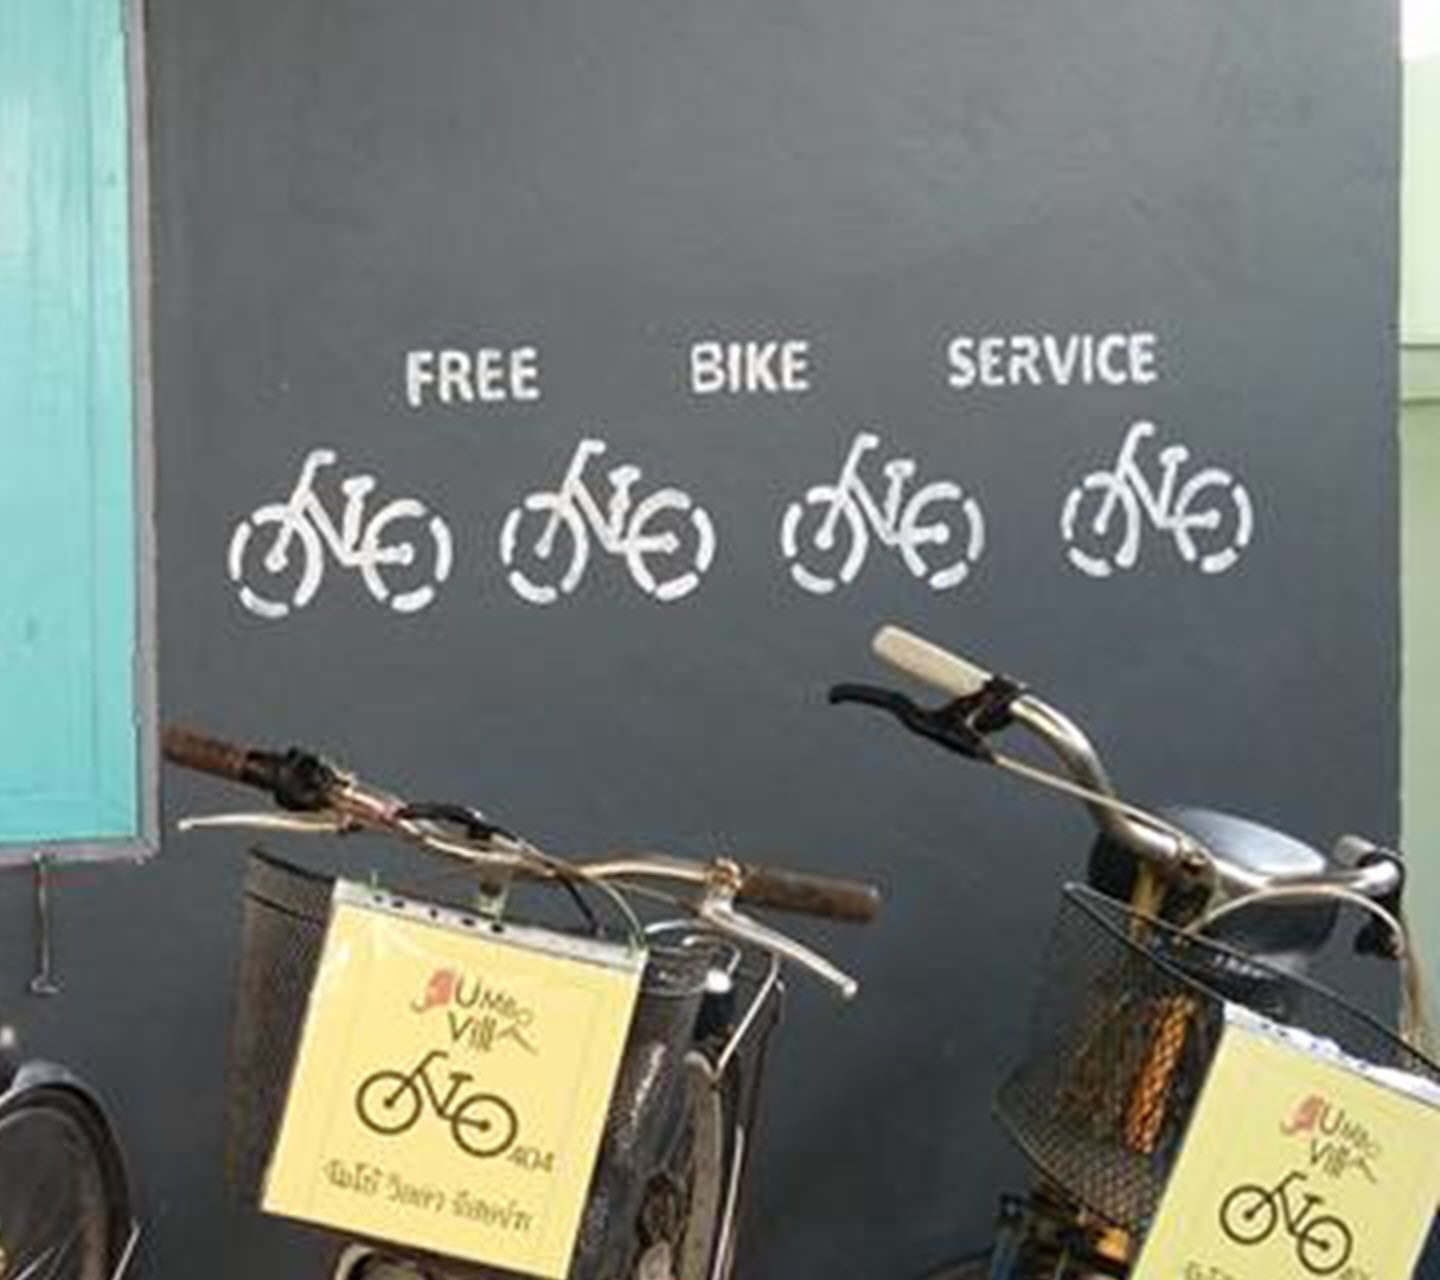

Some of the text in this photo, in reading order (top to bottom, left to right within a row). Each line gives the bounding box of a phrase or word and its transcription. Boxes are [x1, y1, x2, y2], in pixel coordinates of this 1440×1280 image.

[406, 332, 1158, 407] FREE BIKE SERVICE
[507, 1147, 556, 1174] 404
